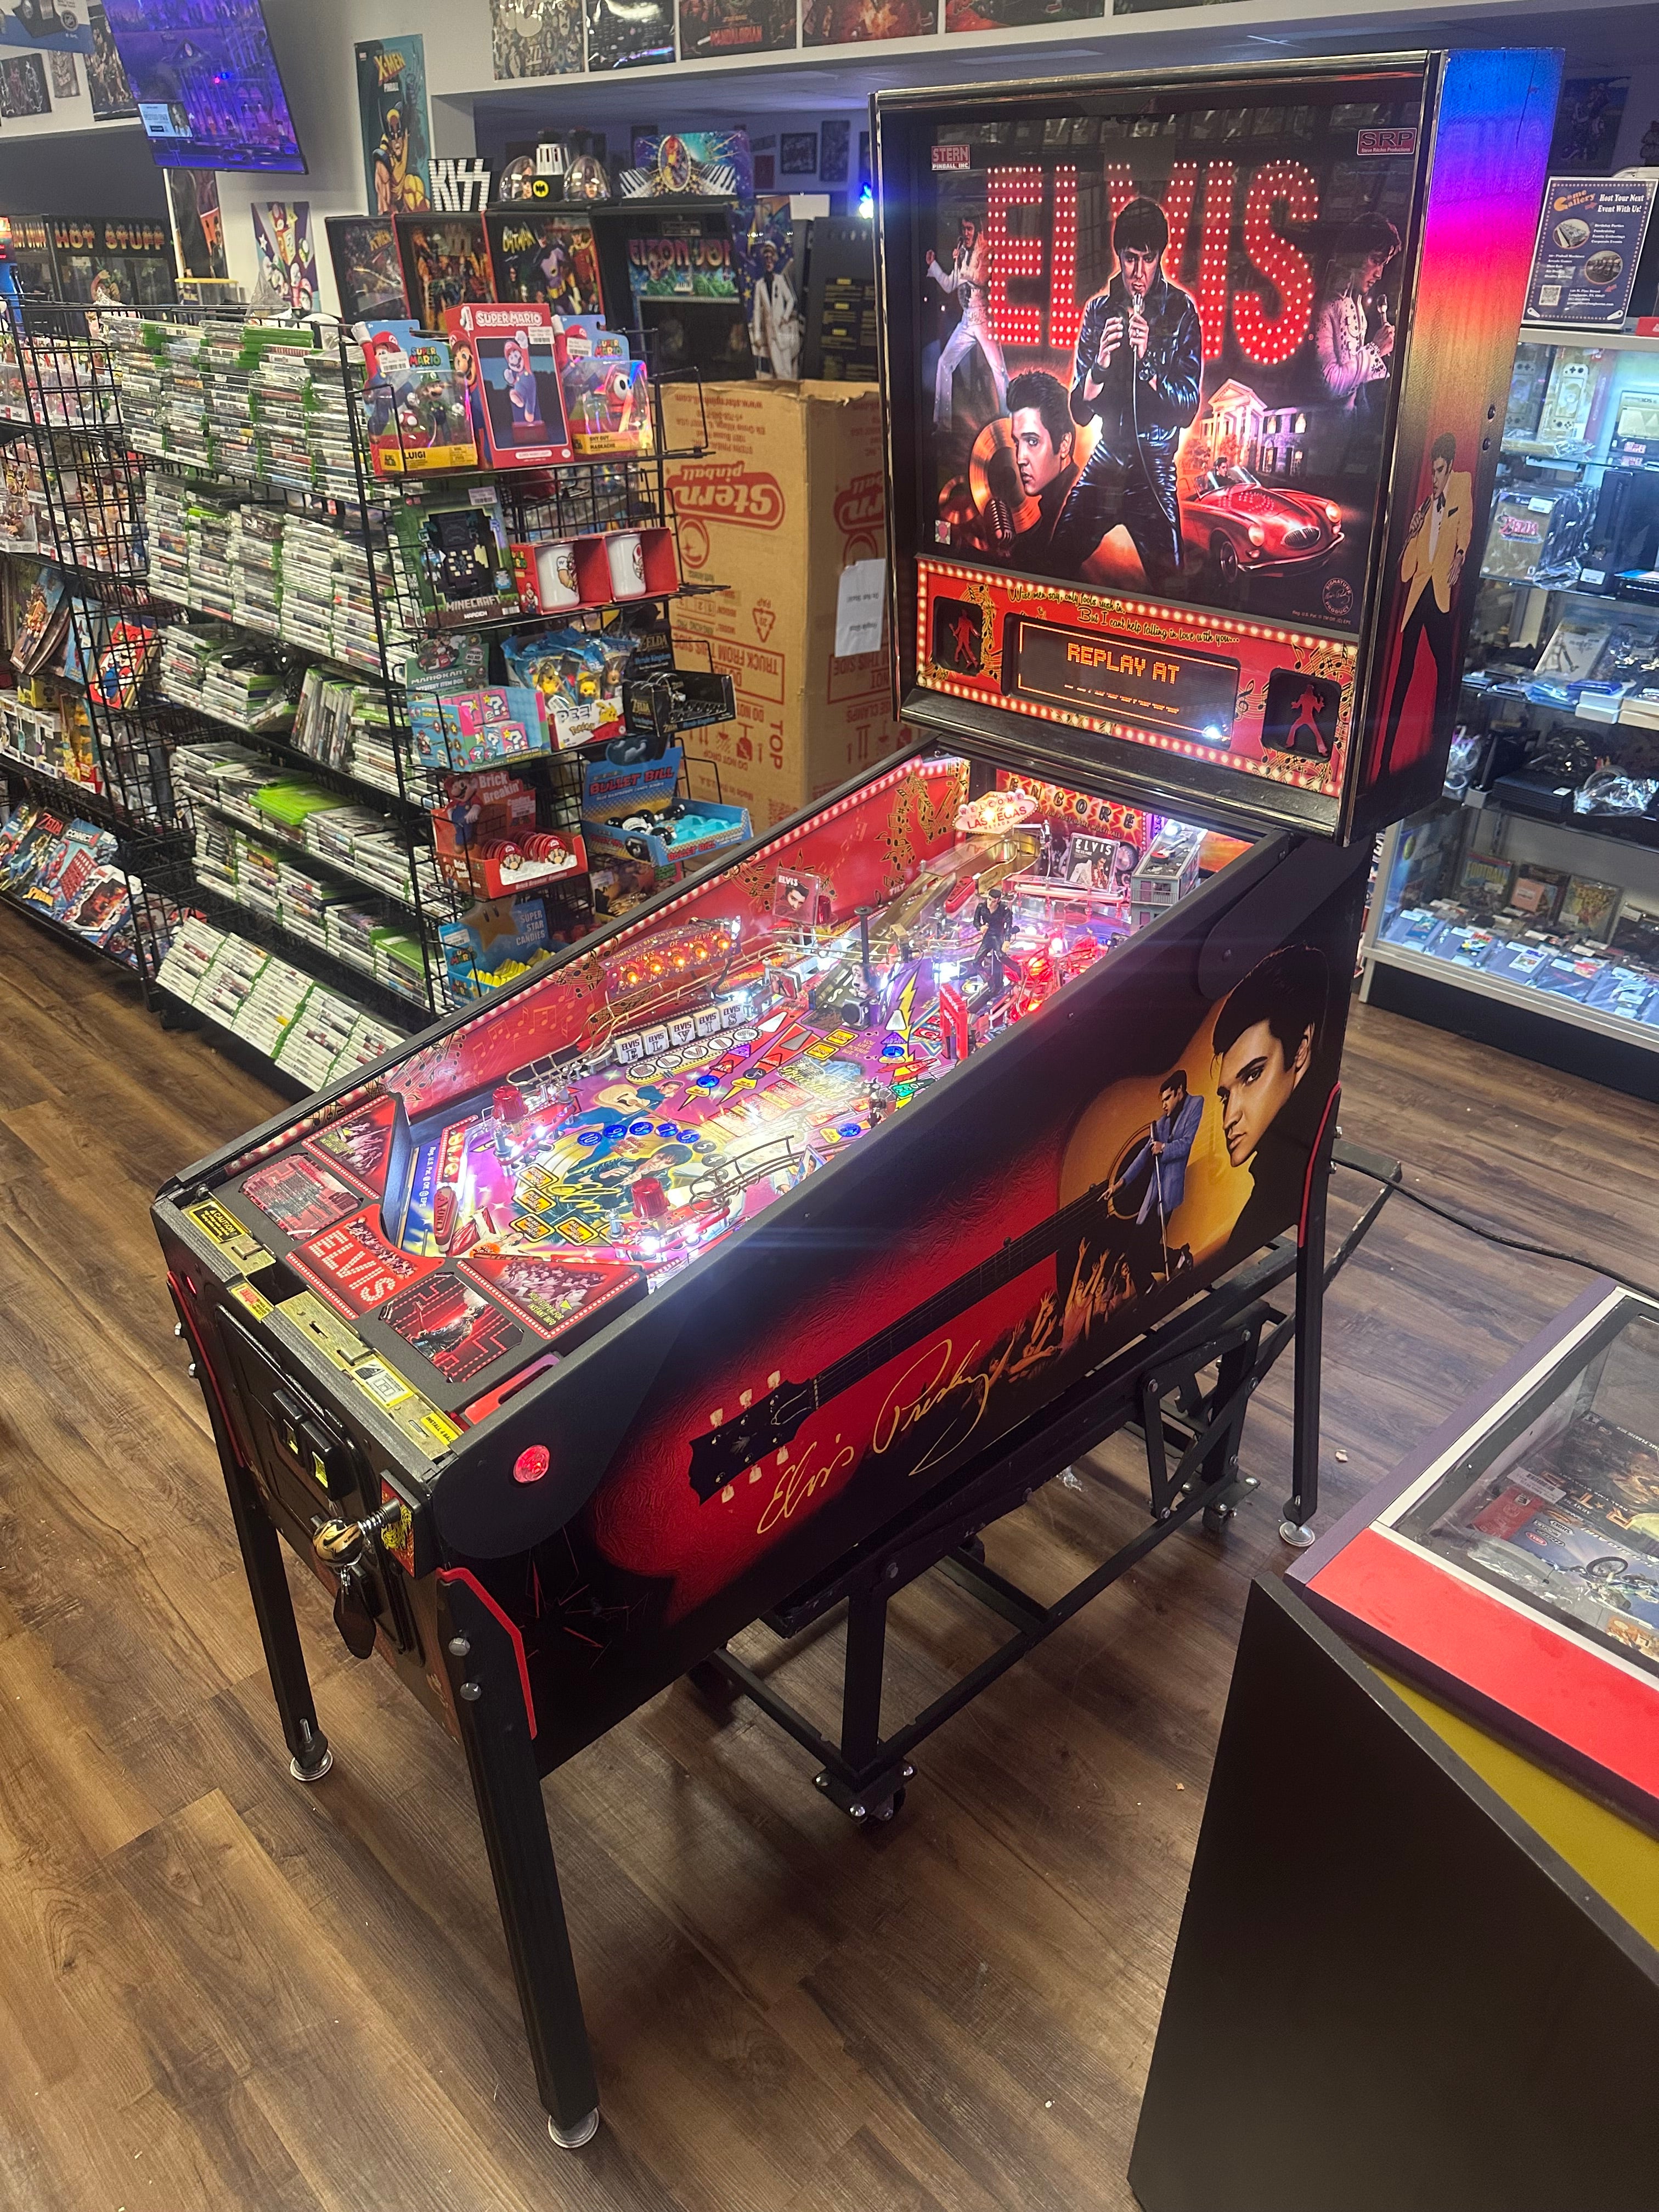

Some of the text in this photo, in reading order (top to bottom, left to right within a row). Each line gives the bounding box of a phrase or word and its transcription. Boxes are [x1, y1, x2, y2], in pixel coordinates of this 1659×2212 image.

[374, 52, 406, 84] X-MEN
[1361, 131, 1414, 146] SRP
[932, 146, 969, 162] STERN
[430, 159, 490, 211] KISS
[55, 223, 95, 249] HOT
[106, 224, 165, 251] STUFF
[502, 223, 536, 252] BATMAN
[629, 240, 689, 267] ELTON
[987, 159, 1321, 364] ELVIS
[476, 311, 542, 326] SUPER MARIO
[411, 347, 436, 356] SUPER
[595, 346, 622, 357] MARIO
[409, 356, 441, 366] MARIO
[404, 452, 426, 460] LUIGI
[684, 465, 743, 482] pinball
[674, 483, 774, 515] Stern
[1498, 514, 1540, 537] ZELDA
[446, 595, 501, 612] MINECRAFT
[1008, 586, 1031, 603] Wise
[1048, 590, 1063, 602] say,
[1064, 593, 1079, 606] only
[1080, 592, 1097, 606] fools
[1116, 600, 1126, 614] in.
[1077, 606, 1240, 646] But I help falling in love with you...
[639, 633, 668, 651] ZELDA
[718, 645, 745, 666] FROM
[747, 652, 778, 676] TRUCK
[1067, 642, 1180, 685] REPLAY AT
[631, 698, 650, 713] ZELDA
[770, 720, 783, 770] TOP
[479, 773, 507, 788] Brick
[589, 774, 642, 795] BULLET
[644, 767, 674, 783] BILL
[483, 780, 520, 804] Breakin'
[959, 788, 1024, 815] WELCOME
[1009, 777, 1135, 830] ENCORE
[36, 812, 64, 835] ZELDA
[967, 818, 988, 830] LAS
[66, 829, 99, 845] CONNECT 4
[668, 847, 696, 861] BULLET
[1075, 838, 1113, 856] ELVIS
[778, 874, 799, 887] ELVIS
[1466, 861, 1511, 887] FOOTBALL
[521, 910, 543, 923] SUPER
[527, 921, 544, 932] STAR
[516, 932, 545, 946] CANDIES
[669, 940, 680, 948] OF
[693, 932, 715, 942] ELVIS
[723, 1005, 741, 1015] ELVIS
[674, 1023, 692, 1032] ELVIS
[699, 1015, 716, 1024] ELVIS
[622, 1040, 640, 1049] ELVIS
[649, 1032, 664, 1041] ELVIS
[584, 1133, 597, 1144] 10
[427, 1147, 436, 1157] Reg.
[425, 1166, 433, 1175] Pat.
[419, 1197, 427, 1207] EPE
[213, 1211, 236, 1234] CAUTION
[308, 1230, 396, 1303] ELVIS
[528, 1291, 565, 1322] HOLD FLIPPER FOR
[528, 1304, 556, 1327] INSTANT INFO
[426, 1416, 441, 1432] INSTALL
[756, 1338, 991, 1535] Elvis Presley
[1570, 1492, 1633, 1530] R T
